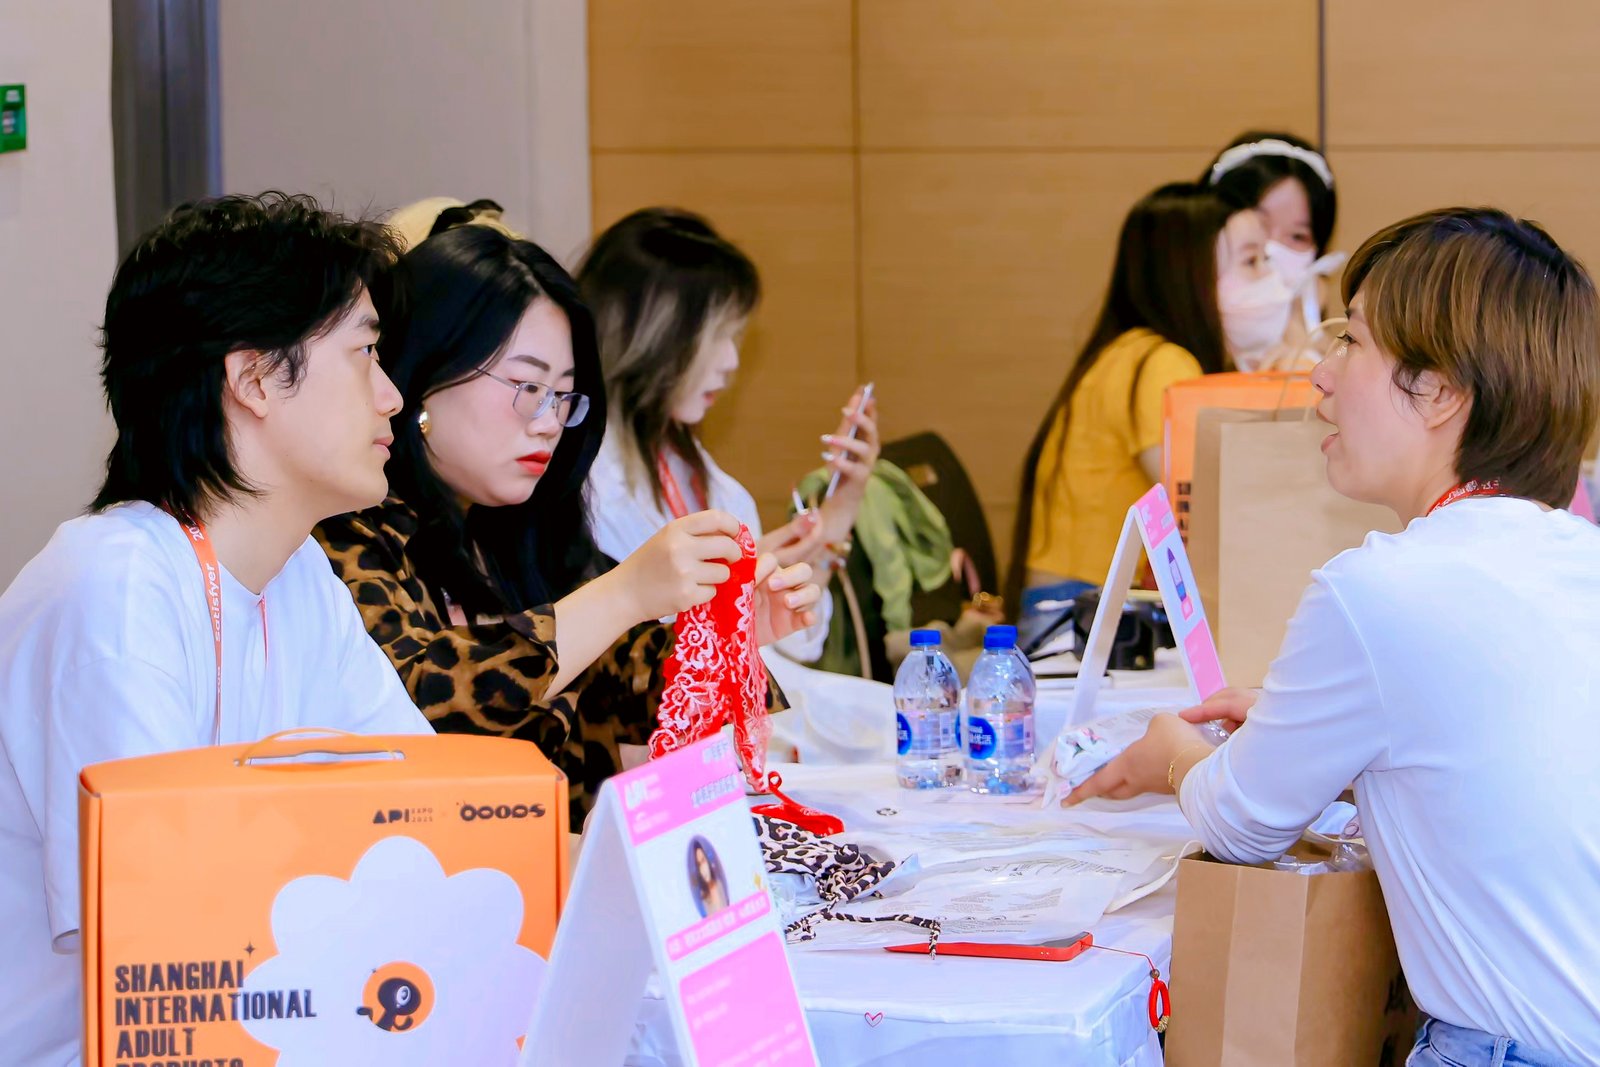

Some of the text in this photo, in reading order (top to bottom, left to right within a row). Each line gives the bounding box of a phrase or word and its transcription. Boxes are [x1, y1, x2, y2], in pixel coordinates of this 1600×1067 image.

[205, 562, 221, 642] satisfyer
[373, 809, 410, 824] API
[115, 960, 244, 993] SHANGHAI
[115, 989, 317, 1026] INTERNATIONAL
[116, 1027, 196, 1059] ADULT
